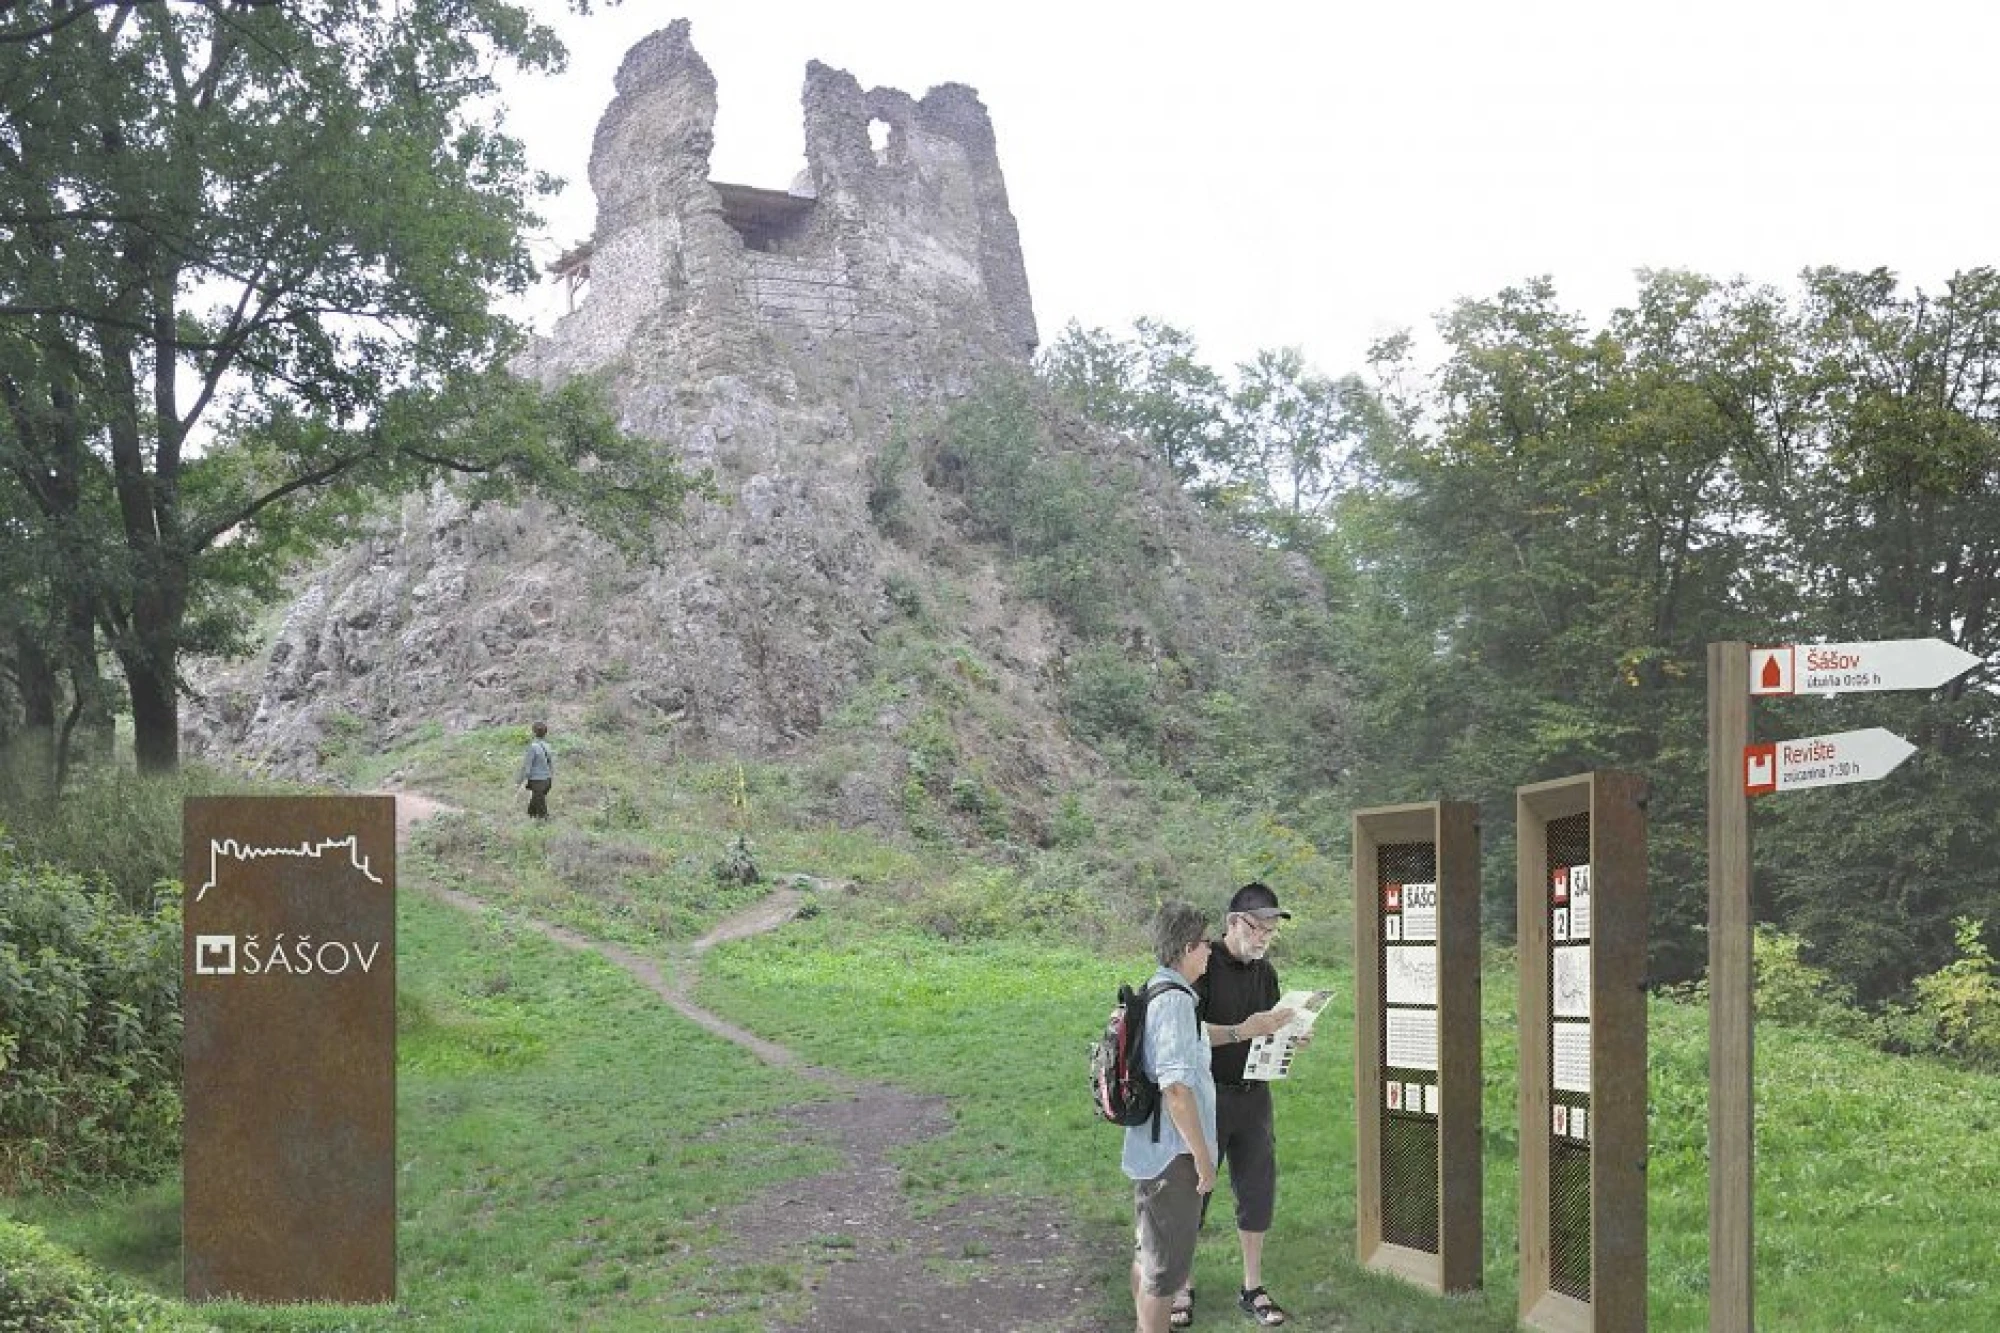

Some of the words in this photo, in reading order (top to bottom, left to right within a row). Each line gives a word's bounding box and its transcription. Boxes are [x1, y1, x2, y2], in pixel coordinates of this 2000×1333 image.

[1808, 647, 1860, 671] Šášov
[1873, 673, 1881, 684] h
[1853, 760, 1860, 774] h
[1388, 919, 1394, 935] 1
[1558, 914, 1565, 934] 2
[242, 933, 379, 974] ŠÁŠOV
